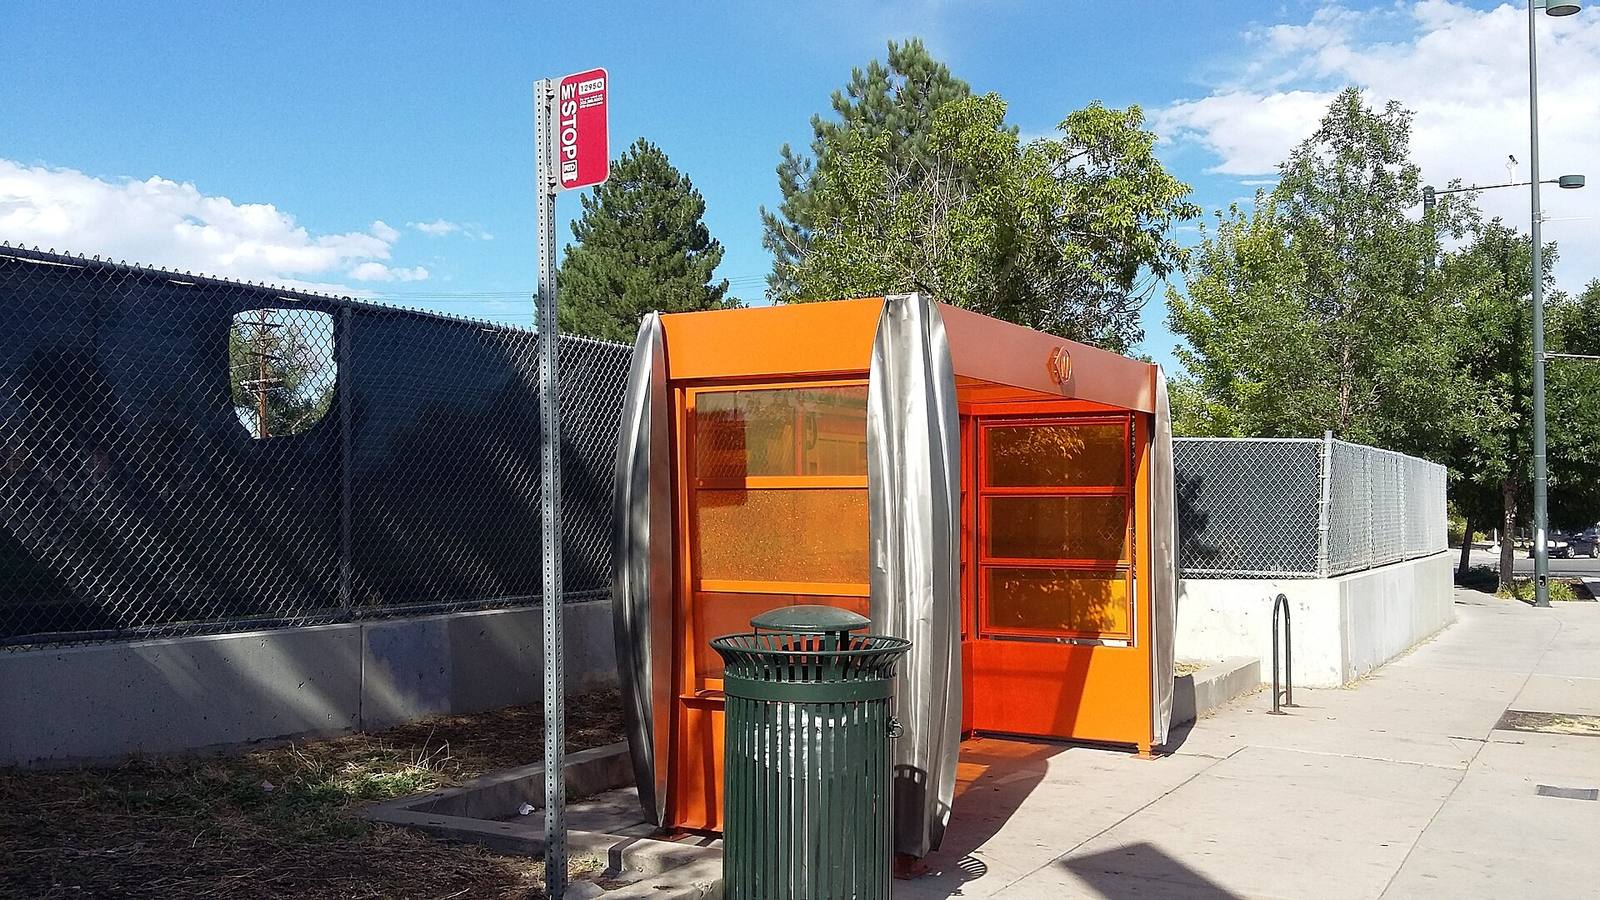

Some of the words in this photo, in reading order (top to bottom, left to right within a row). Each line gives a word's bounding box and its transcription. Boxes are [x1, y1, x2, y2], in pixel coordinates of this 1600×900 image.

[562, 83, 577, 100] MY
[581, 81, 602, 92] 12950
[562, 101, 577, 160] STOP
